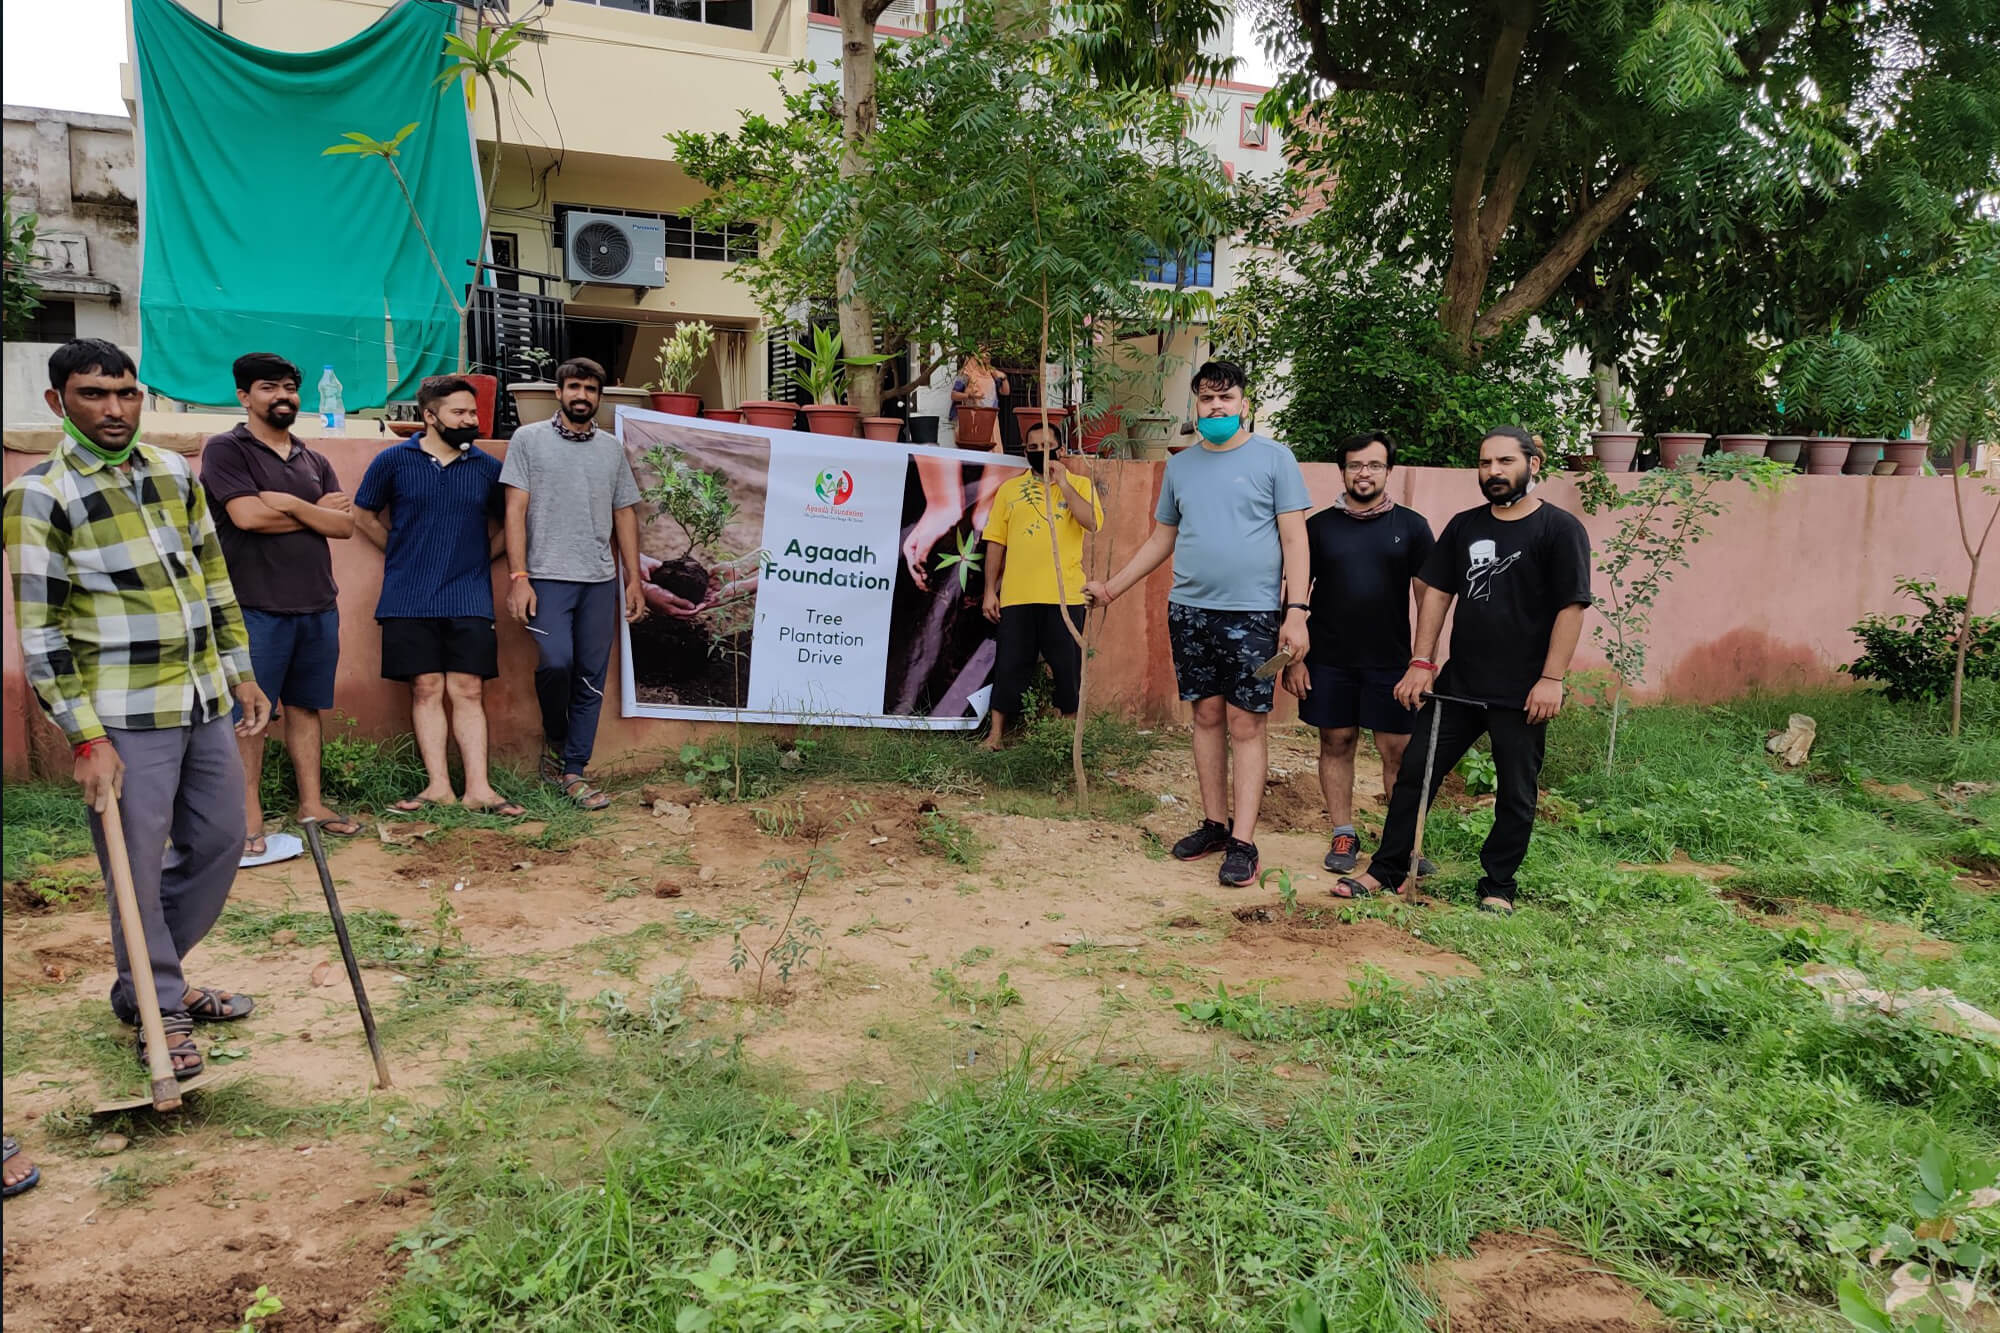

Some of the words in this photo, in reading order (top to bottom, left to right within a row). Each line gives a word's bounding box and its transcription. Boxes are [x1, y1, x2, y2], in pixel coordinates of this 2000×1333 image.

[784, 538, 877, 565] Agaadh
[765, 562, 890, 591] Foundation
[806, 609, 843, 625] Tree
[779, 626, 864, 647] Plantation
[798, 648, 843, 665] Drive
